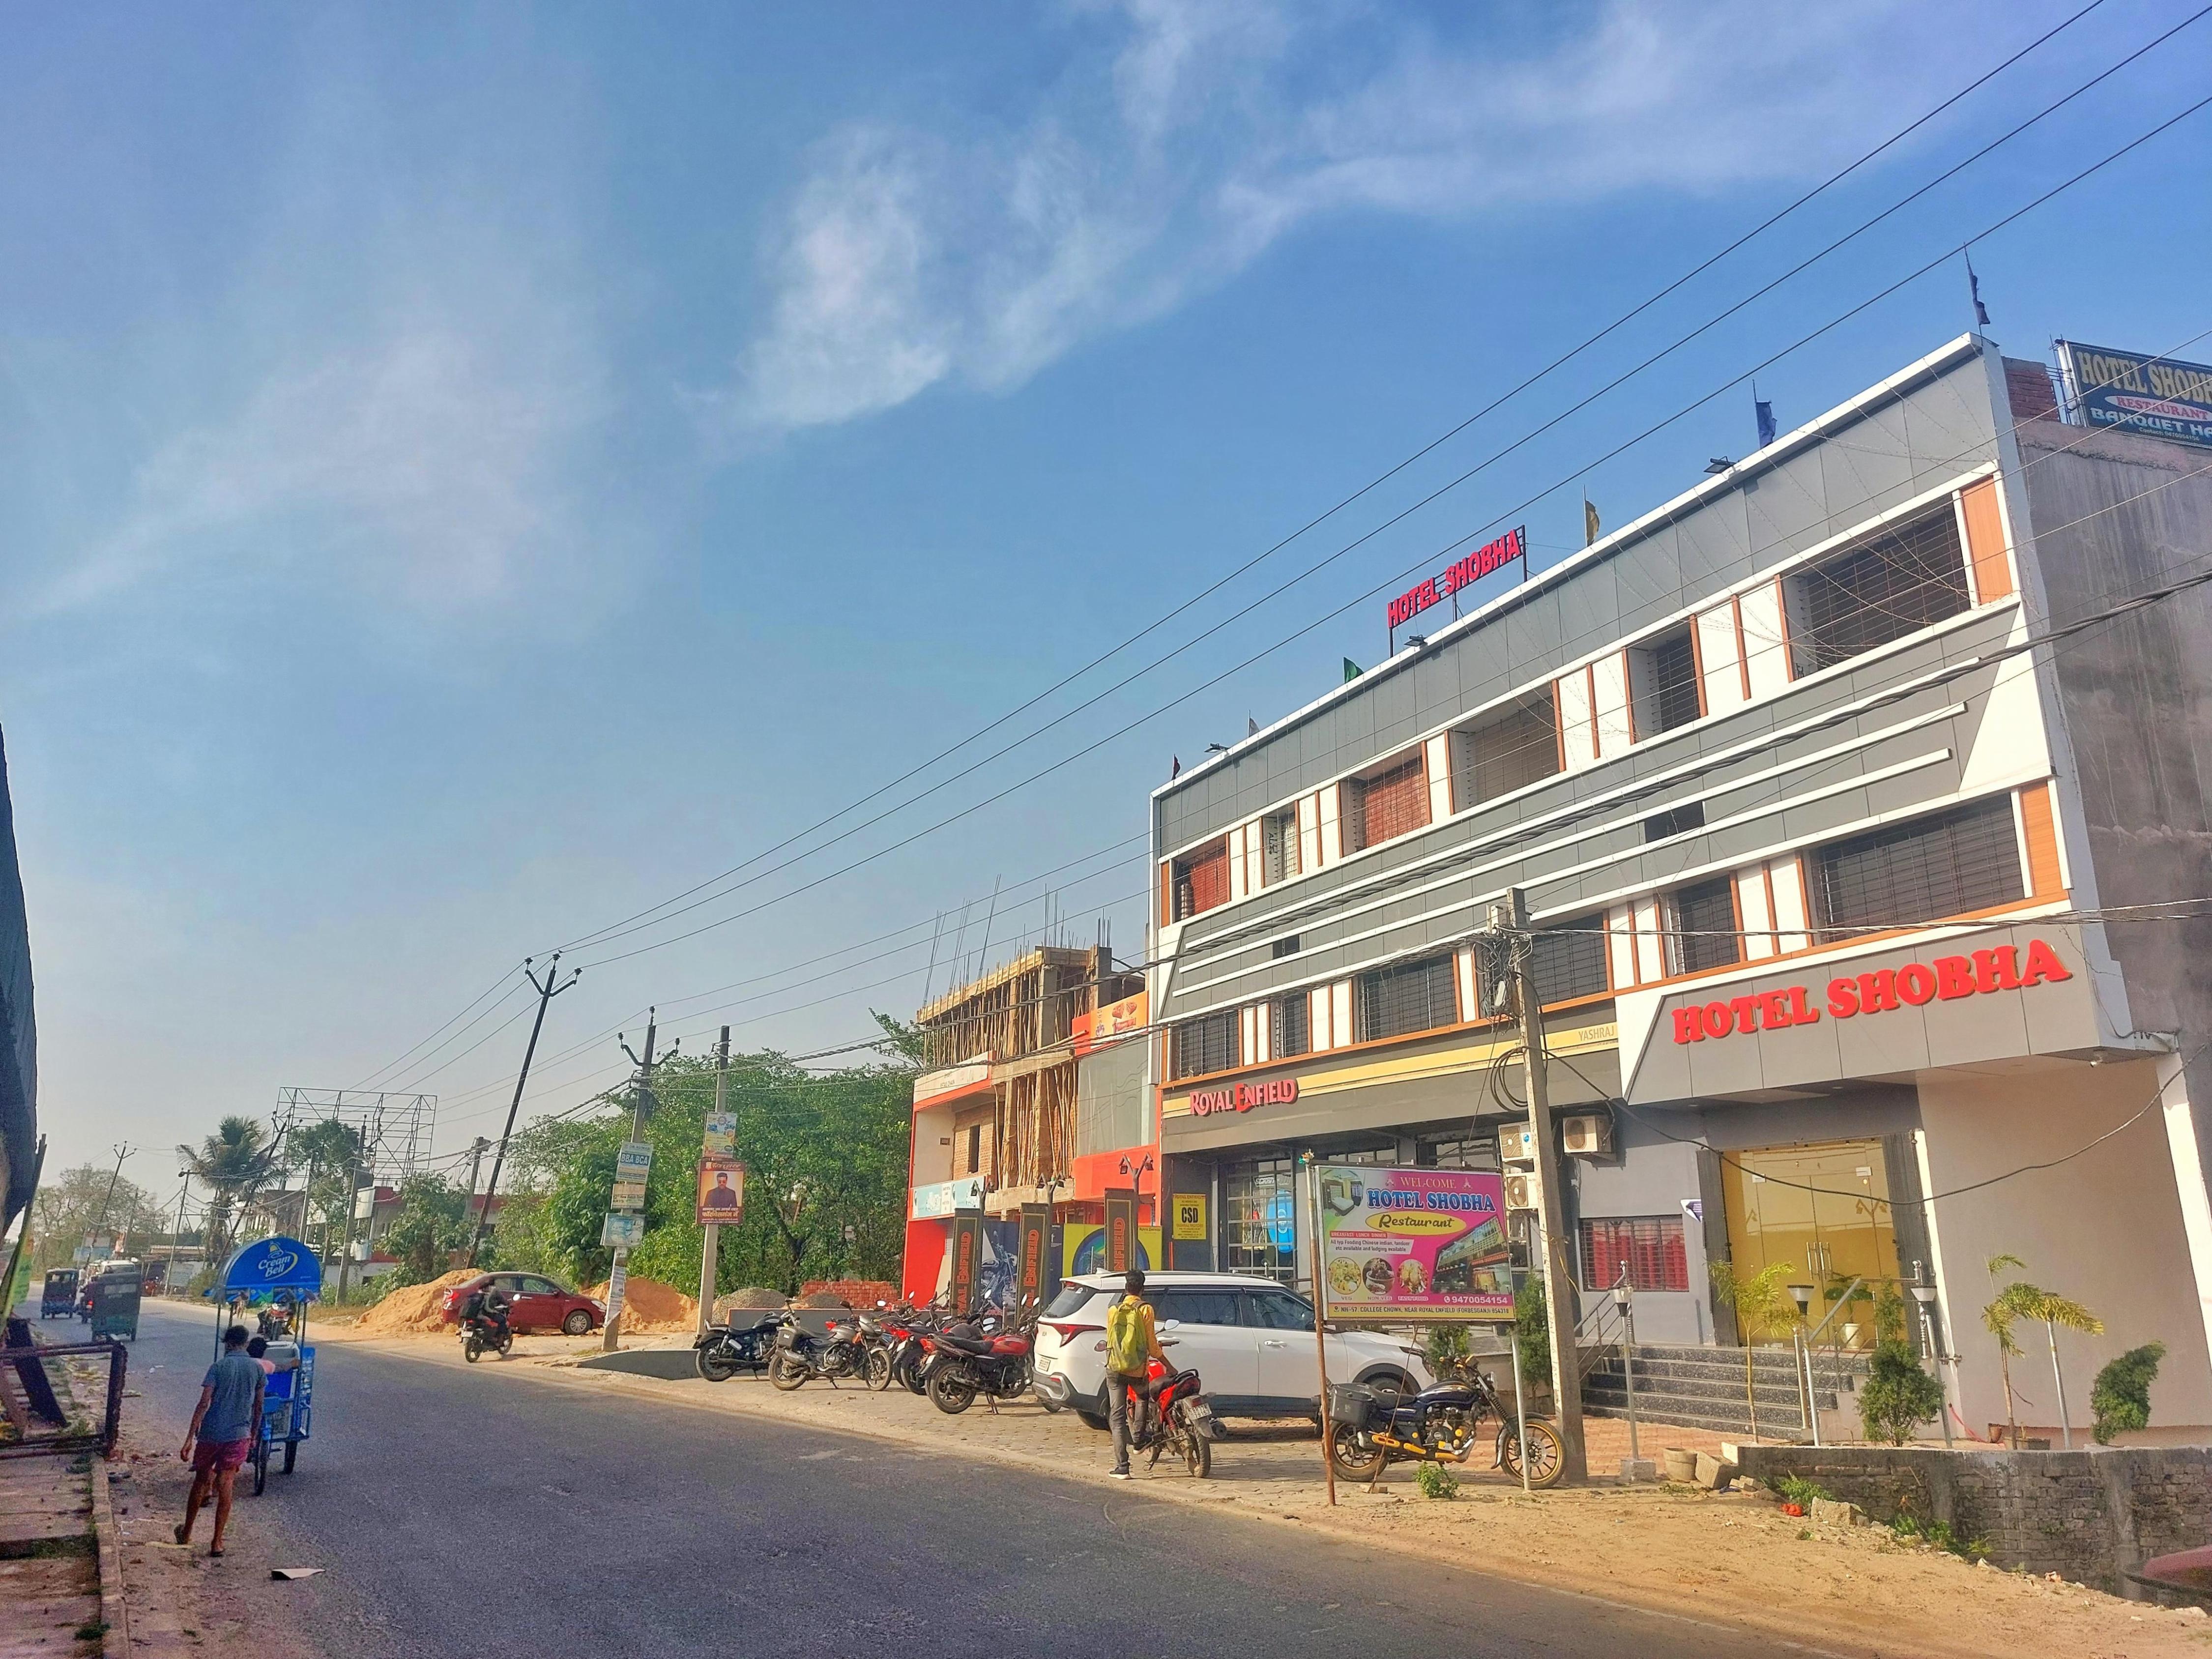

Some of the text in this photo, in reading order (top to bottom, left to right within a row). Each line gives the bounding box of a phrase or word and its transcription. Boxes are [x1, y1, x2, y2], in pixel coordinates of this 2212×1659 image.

[2076, 351, 2148, 394] HOTEL
[2090, 407, 2184, 432] BANQUET
[2116, 396, 2208, 420] RESTAURANT
[1387, 528, 1522, 628] HOTEL SHOBHA
[1671, 939, 2072, 1045] HOTEL SHOBHA
[1578, 1025, 1615, 1041] YASHRAJ
[1189, 1079, 1296, 1116] ROYAL ENFIELD
[621, 1153, 648, 1164] BBA BCA
[1367, 1189, 1496, 1212] HOTEL SHOBHA
[1182, 1207, 1198, 1223] CSD
[1378, 1214, 1455, 1228] Restaurant
[1114, 1217, 1125, 1271] NFIELD
[258, 1255, 291, 1270] Cream
[1023, 1229, 1039, 1286] ENFIELD
[265, 1264, 285, 1278] Bell
[957, 1231, 971, 1314] YAL ENFIELD
